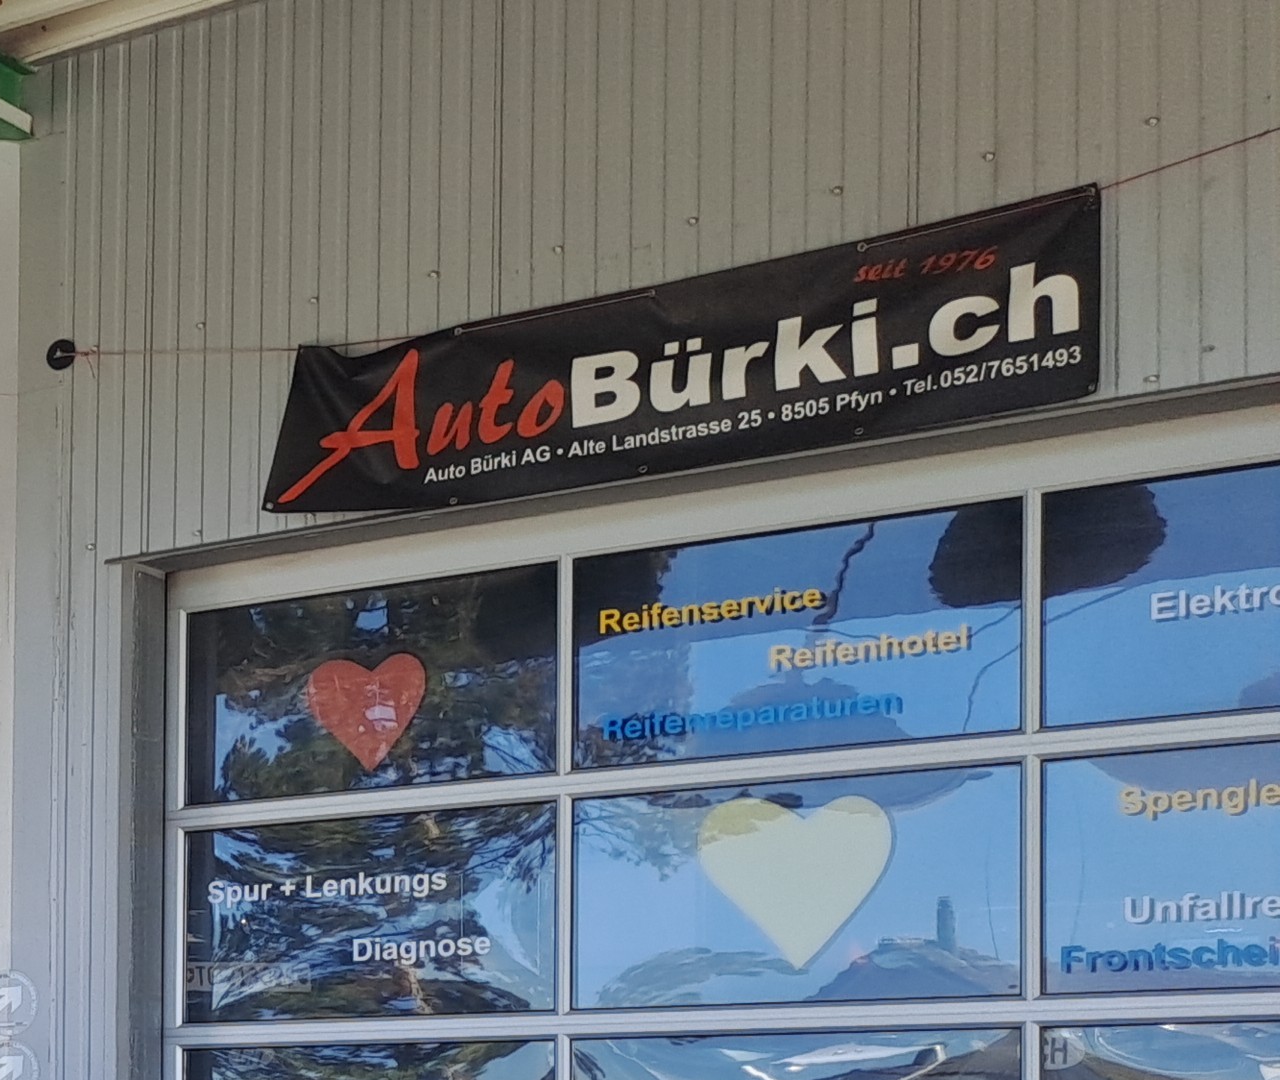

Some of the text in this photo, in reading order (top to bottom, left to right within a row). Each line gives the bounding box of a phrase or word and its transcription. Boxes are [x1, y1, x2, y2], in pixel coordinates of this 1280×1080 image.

[852, 244, 999, 283] seit 1976
[423, 462, 466, 485] Auto
[469, 449, 517, 475] Bürki
[521, 444, 551, 465] AG
[567, 438, 607, 459] Alte
[611, 415, 732, 453] Landstrasse
[738, 409, 762, 431] 25
[780, 397, 830, 423] 8505
[836, 389, 883, 416] Pfyn
[598, 586, 822, 635] Reifenservice
[769, 623, 972, 672] Reifenhotel
[601, 692, 904, 741] Reifenreparaturen
[207, 870, 448, 905] Spur + Lenkungs
[351, 934, 491, 966] Diagnose
